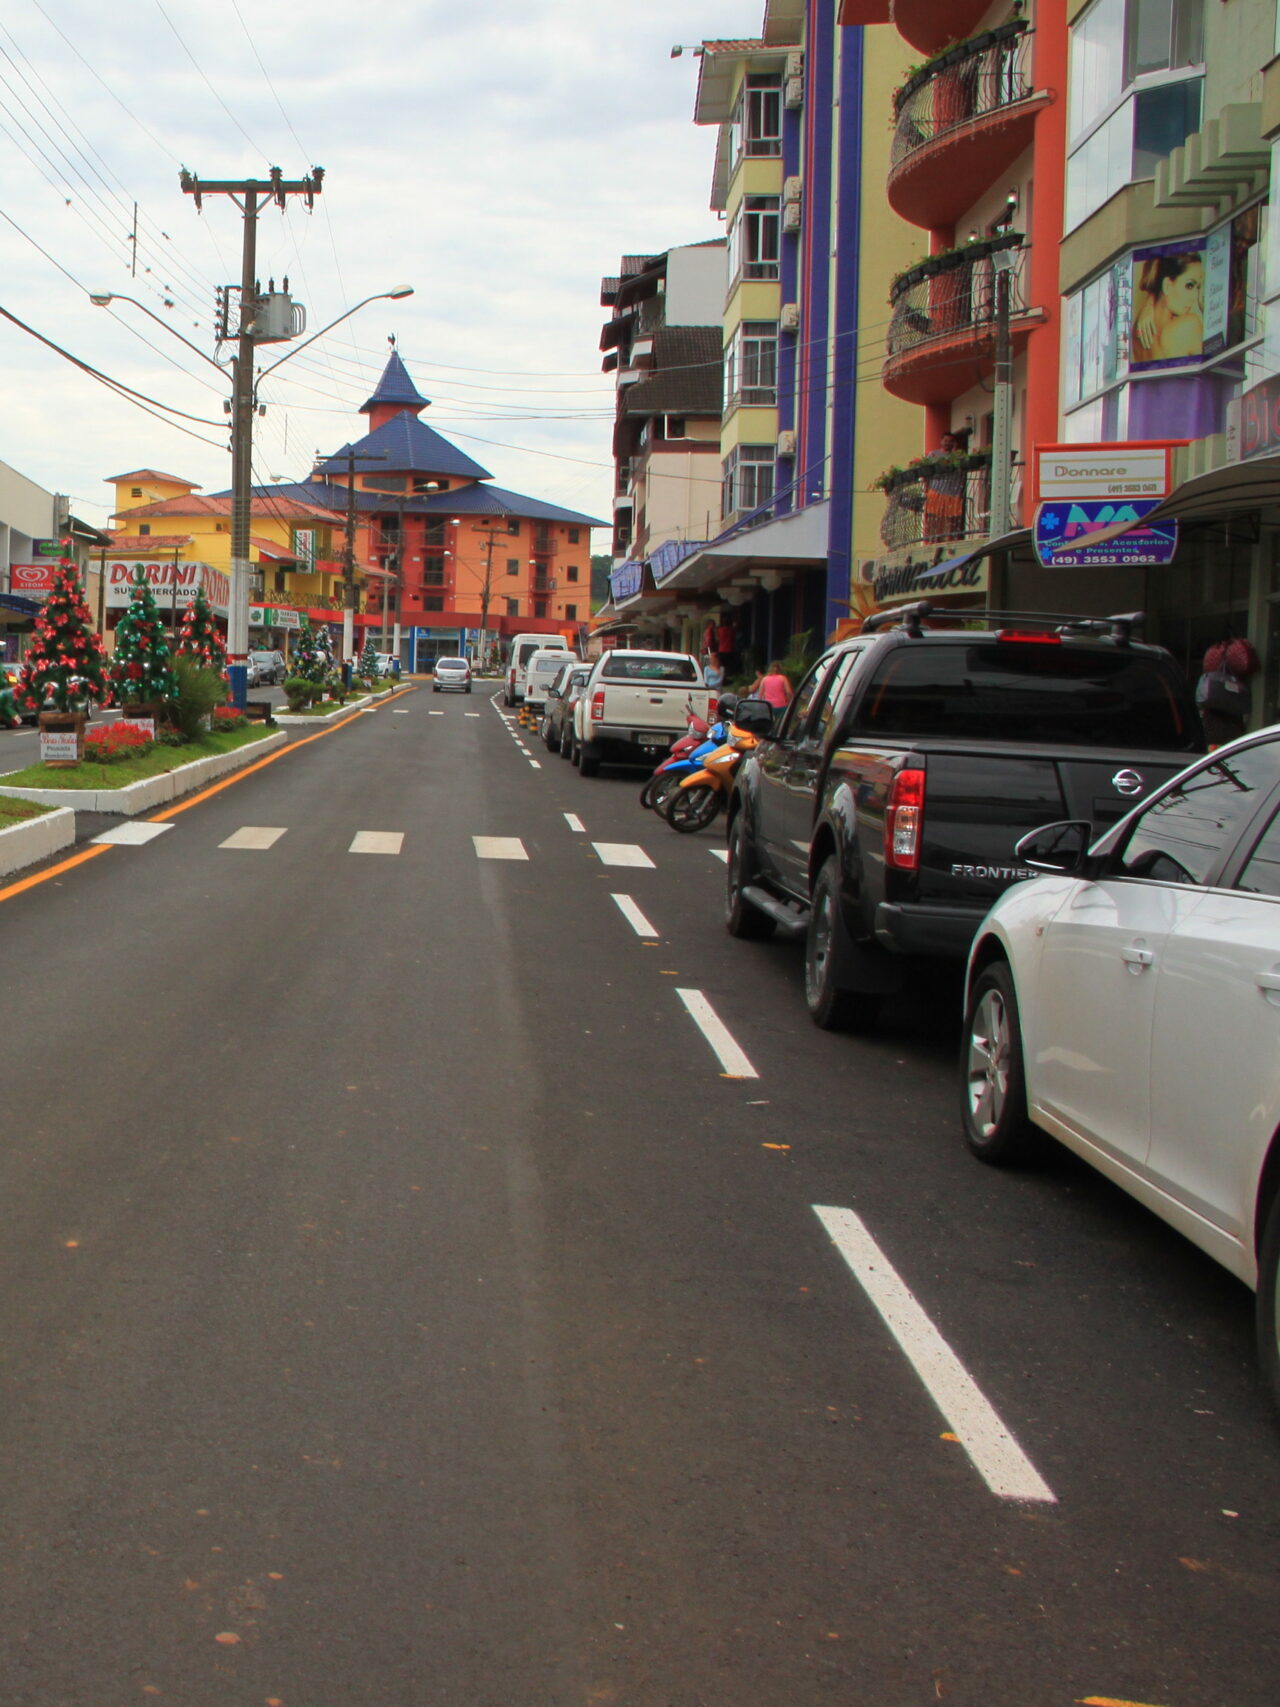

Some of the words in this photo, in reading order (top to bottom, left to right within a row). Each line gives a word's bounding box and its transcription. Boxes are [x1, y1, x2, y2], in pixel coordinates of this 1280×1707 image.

[1054, 465, 1128, 477] Donnare
[1051, 556, 1078, 564] (49)
[1083, 555, 1117, 563] 3553
[1122, 554, 1156, 562] 0962
[951, 864, 1040, 880] FRONTIER
